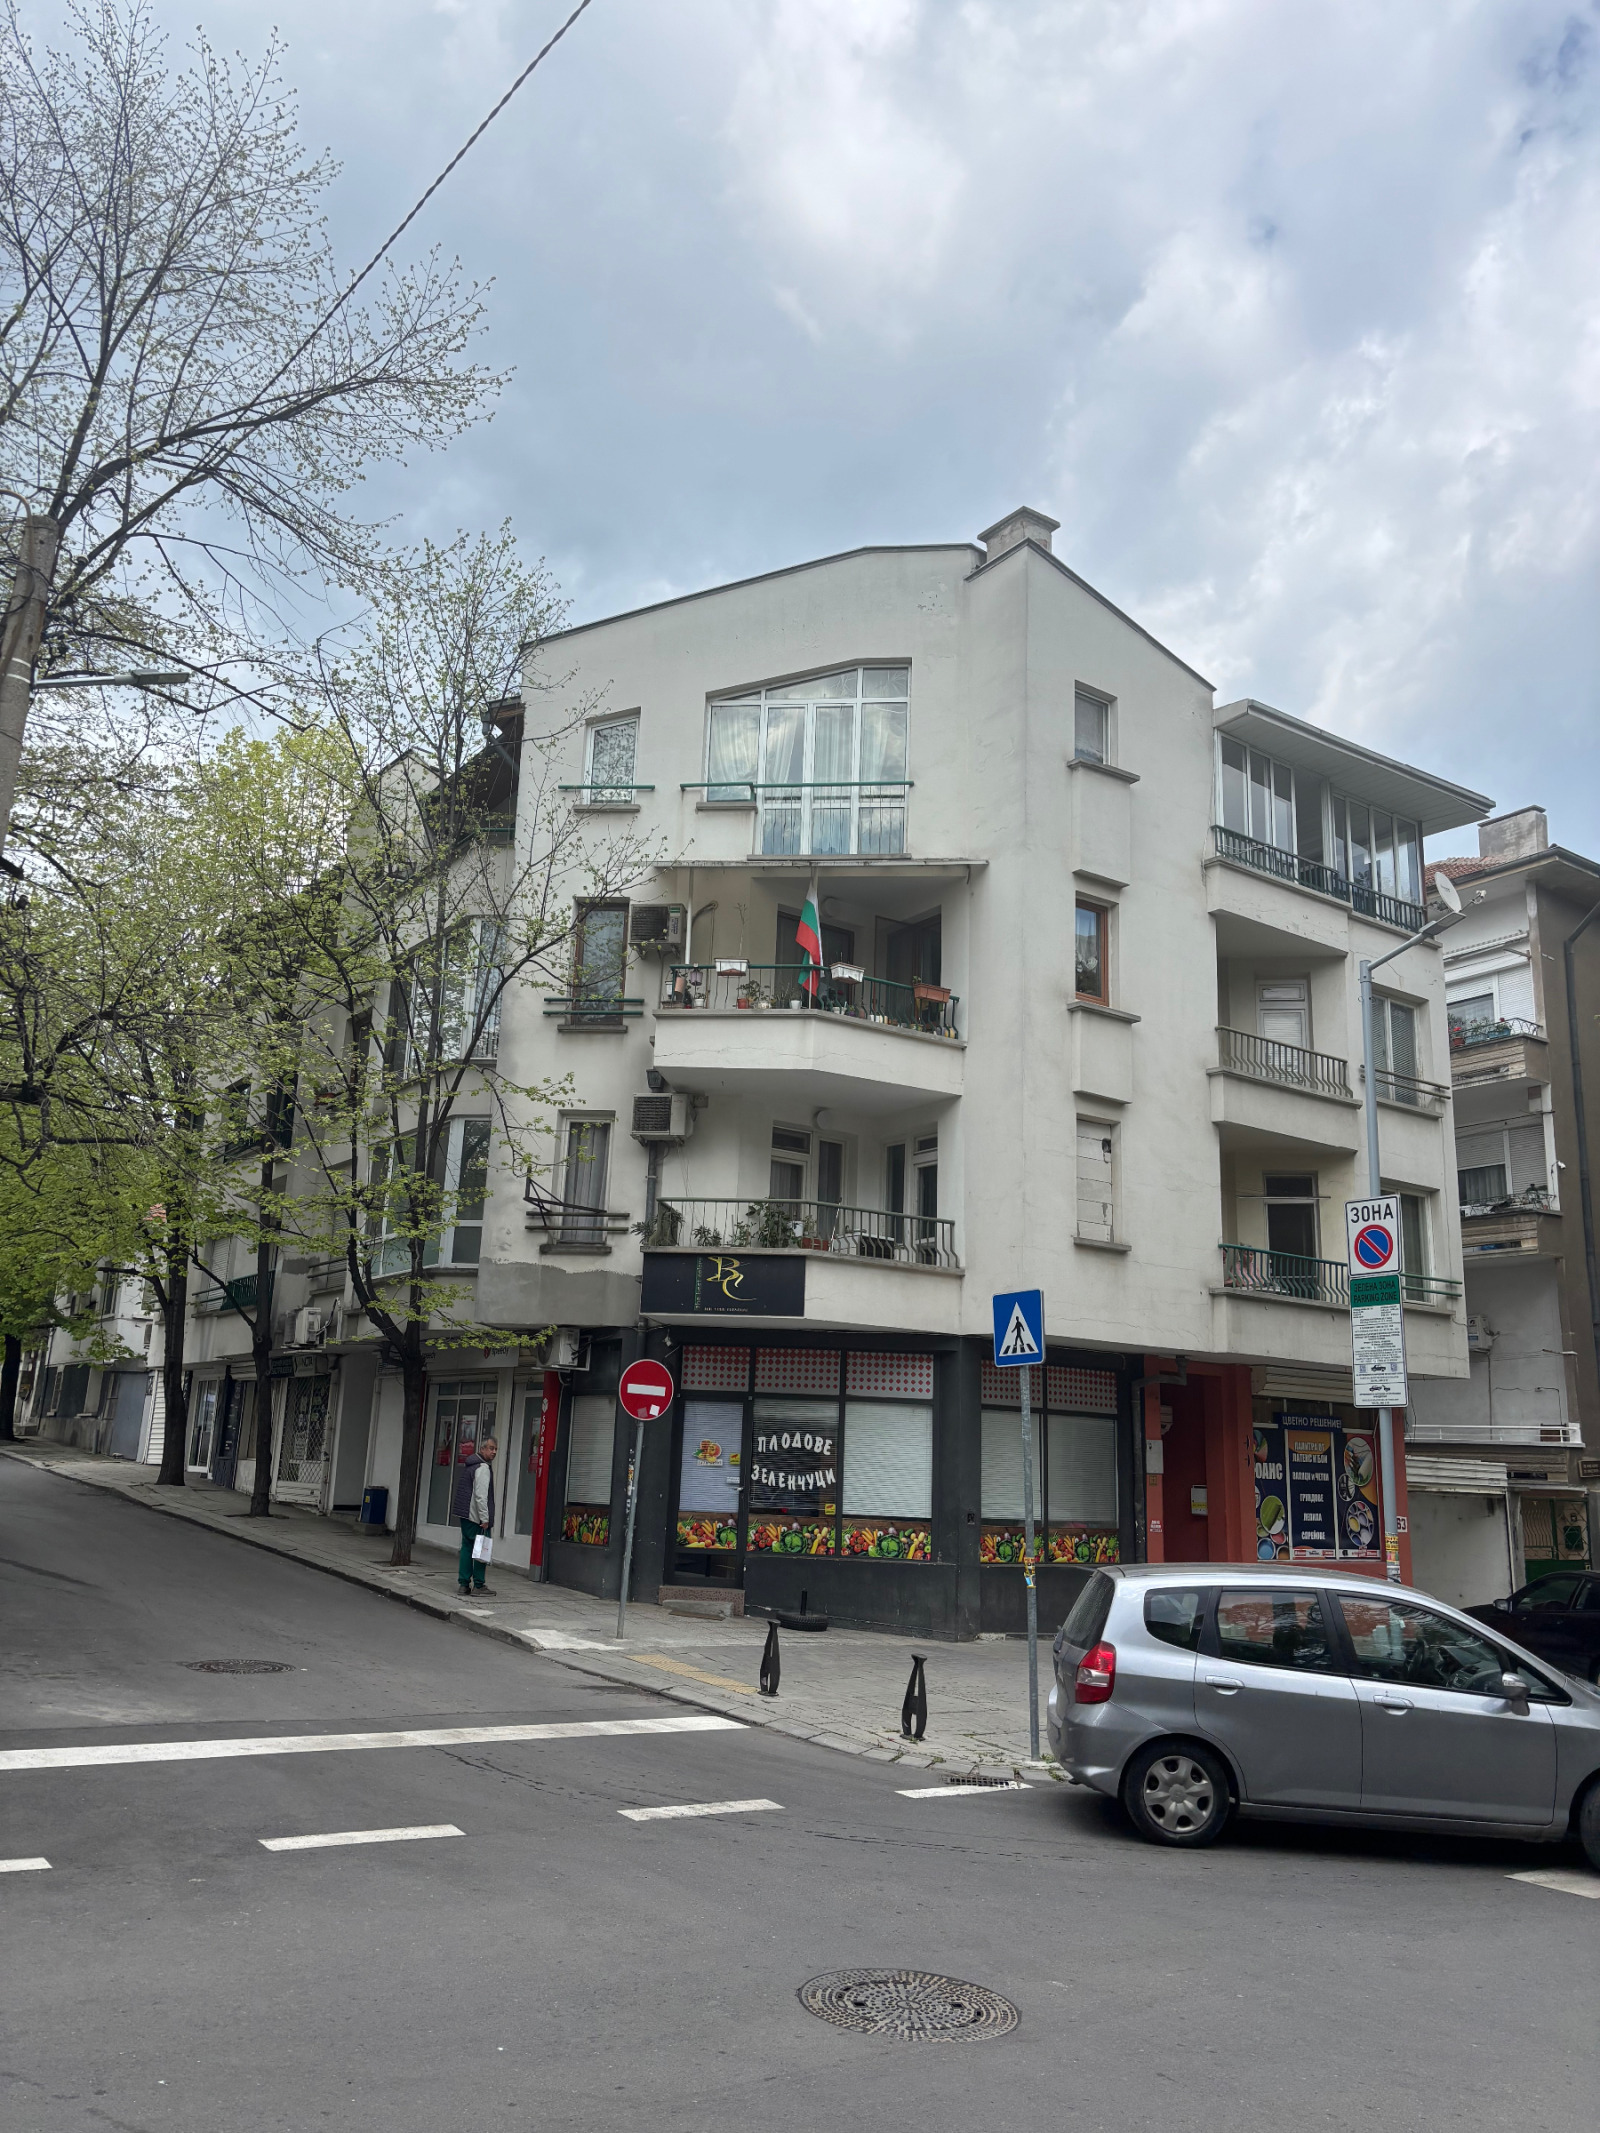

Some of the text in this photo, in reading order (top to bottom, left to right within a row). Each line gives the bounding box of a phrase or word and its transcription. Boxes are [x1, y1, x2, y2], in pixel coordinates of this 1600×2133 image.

[1350, 1203, 1394, 1224] ЗОНА
[1354, 1280, 1396, 1293] ЗЕЛЕНА ЗОНА
[1353, 1291, 1398, 1304] PARKING ZONE
[1282, 1415, 1342, 1429] ЦВЕТНО РЕШЕНИЕ!
[757, 1432, 833, 1456] ПЛОДОВЕ
[750, 1464, 837, 1491] ЗЕЛЕНЧУЦИ
[1254, 1462, 1283, 1480] ЮАНС
[1396, 1518, 1406, 1530] 63
